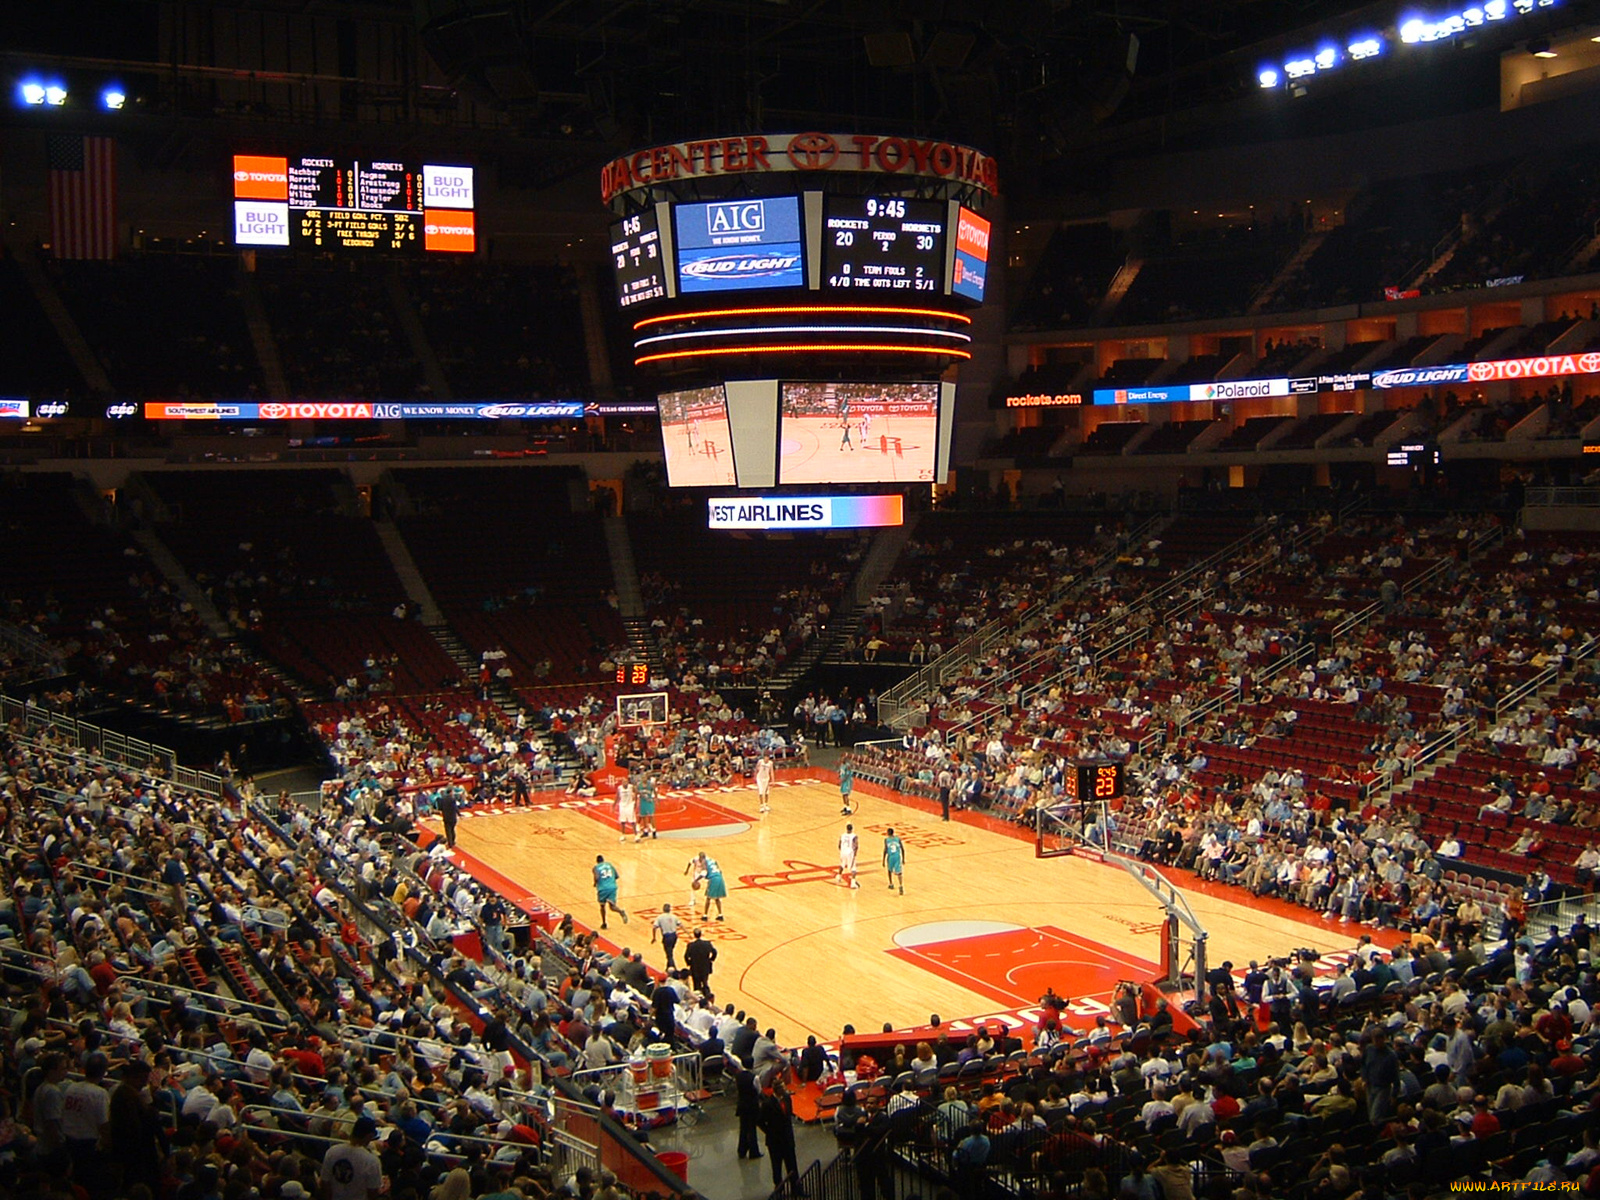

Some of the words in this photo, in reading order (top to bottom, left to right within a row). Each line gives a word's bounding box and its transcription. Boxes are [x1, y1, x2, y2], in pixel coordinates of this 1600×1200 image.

[631, 136, 770, 183] CENTER
[852, 136, 985, 182] TOYOTA
[249, 173, 287, 182] TOYOTA
[433, 176, 464, 187] BUD
[427, 187, 470, 198] LIGHT
[867, 199, 905, 218] 9:45
[246, 212, 278, 223] BUD
[712, 205, 762, 231] AIG
[240, 223, 285, 234] LIGHT
[439, 226, 474, 235] TOYOTA
[828, 219, 869, 229] ROCKETS
[901, 223, 941, 233] HORNETS
[836, 232, 853, 246] 20
[873, 231, 896, 241] PERIOD
[916, 236, 933, 250] 30
[966, 222, 988, 250] TOYOTA
[882, 241, 889, 252] 2
[696, 261, 736, 274] BUD
[737, 258, 798, 271] LIGHT
[843, 264, 850, 274] 0
[863, 266, 882, 275] TEAM
[884, 266, 905, 275] FOULS
[916, 267, 923, 277] 2
[830, 276, 850, 287] 4/0
[854, 278, 871, 287] TIME
[873, 279, 891, 288] OUTS
[893, 280, 911, 288] LEFT
[915, 279, 934, 290] 5/1
[1494, 357, 1576, 376] TOYOTA
[1386, 373, 1413, 384] BUD
[1417, 369, 1465, 382] LIGHT
[1128, 392, 1146, 400] Direct
[1148, 391, 1168, 401] Energy
[1217, 383, 1270, 398] Polaroid
[901, 403, 928, 411] TOYOTA
[1006, 394, 1081, 407] rockets.com
[287, 404, 370, 417] TOYOTA
[375, 404, 399, 417] AIG
[403, 406, 418, 414] WE
[418, 406, 443, 414] KNOW
[444, 406, 475, 414] MONEY
[489, 406, 522, 415] BUD
[527, 406, 579, 415] LIGHT
[857, 404, 884, 412] TOYOTA
[738, 504, 824, 522] AIRLINES
[632, 671, 646, 684] 23
[1096, 777, 1115, 797] 23
[600, 869, 613, 879] 34
